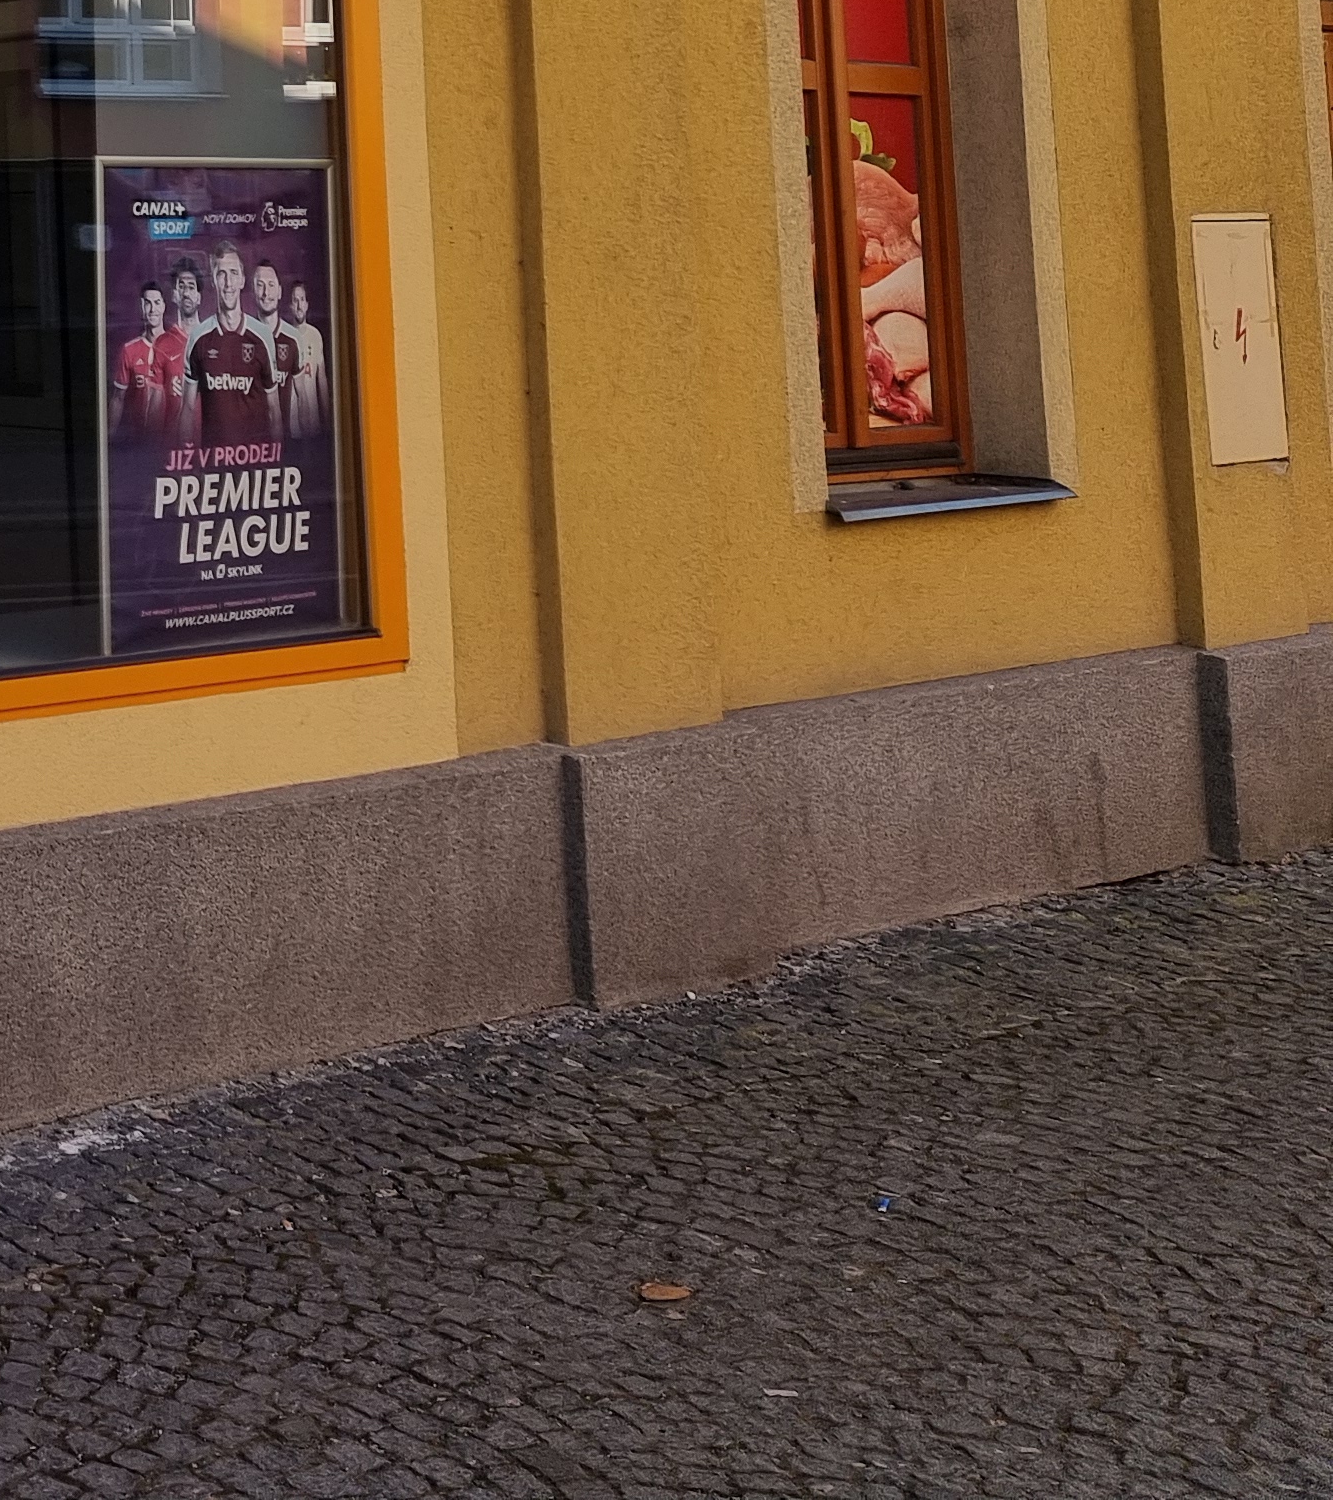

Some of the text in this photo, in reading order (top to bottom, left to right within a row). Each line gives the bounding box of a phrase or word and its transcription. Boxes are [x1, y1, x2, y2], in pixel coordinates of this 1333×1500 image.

[132, 201, 186, 216] CANAL+
[278, 205, 308, 216] Premier
[153, 221, 191, 235] SPORT
[277, 217, 309, 230] League
[206, 372, 254, 395] betway
[166, 443, 282, 471] JIŽ V PRODEJI
[154, 466, 302, 519] PREMIER
[179, 511, 311, 564] LEAGUE
[201, 570, 215, 581] NA
